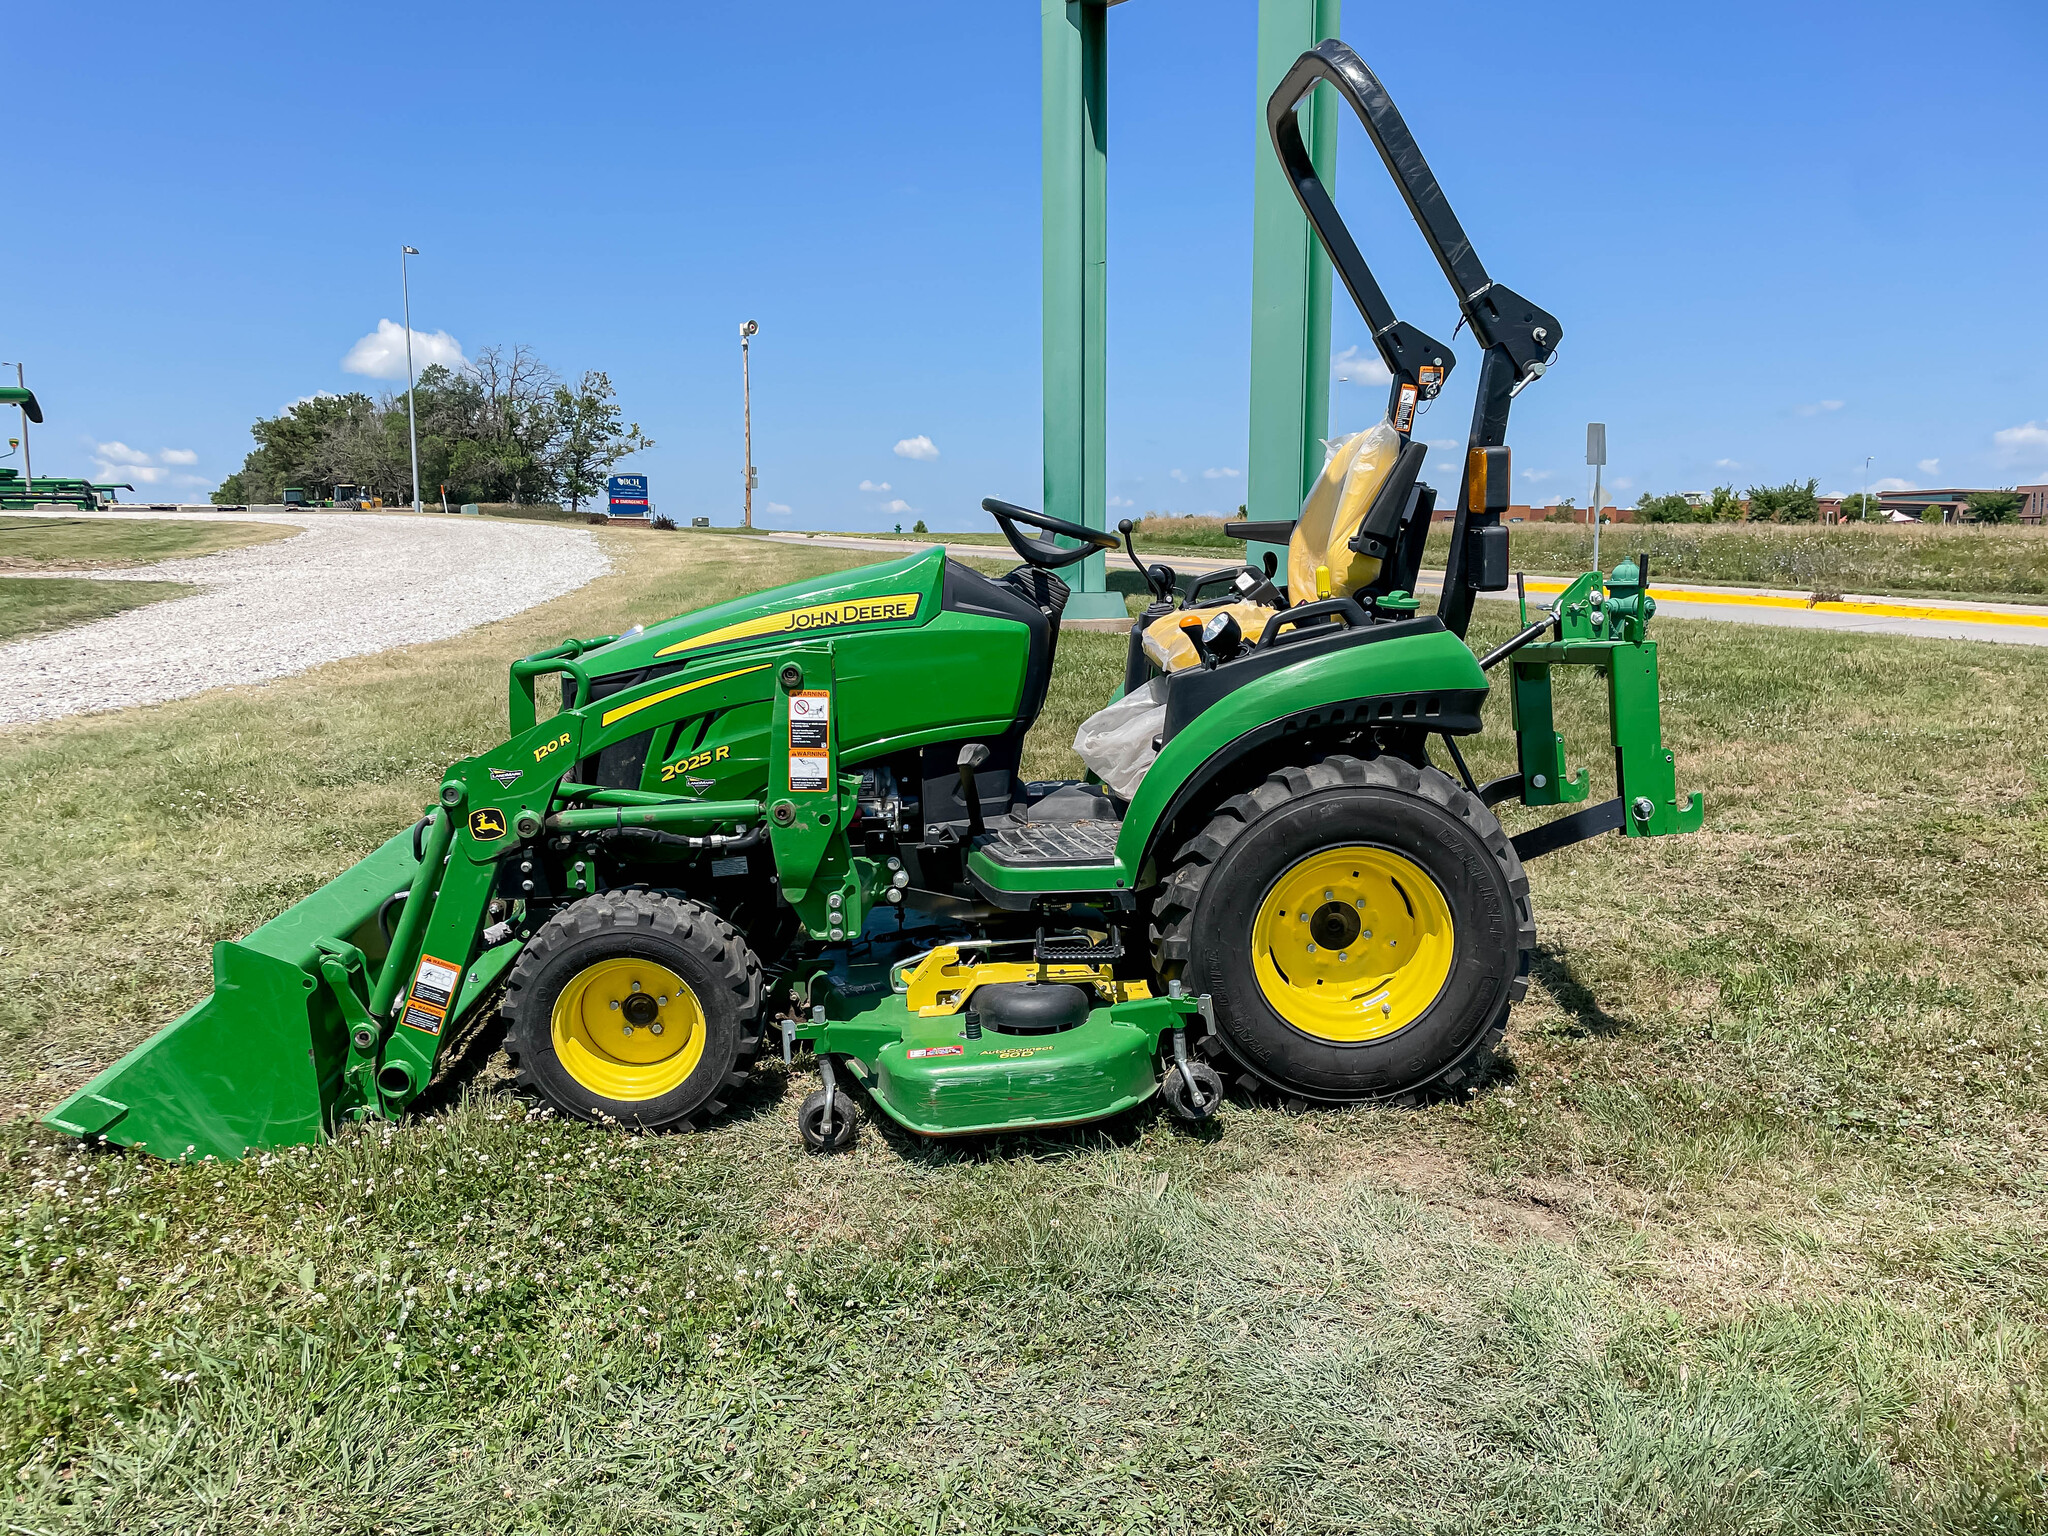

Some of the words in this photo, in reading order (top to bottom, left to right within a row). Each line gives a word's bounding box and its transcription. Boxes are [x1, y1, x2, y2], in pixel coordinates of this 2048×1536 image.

[784, 610, 838, 630] JOHN
[844, 603, 907, 621] DEERE
[533, 740, 559, 763] 120
[559, 732, 571, 747] R
[661, 751, 713, 782] 2025
[715, 745, 731, 762] R
[432, 959, 456, 971] WARNING
[999, 1051, 1034, 1059] 60D
